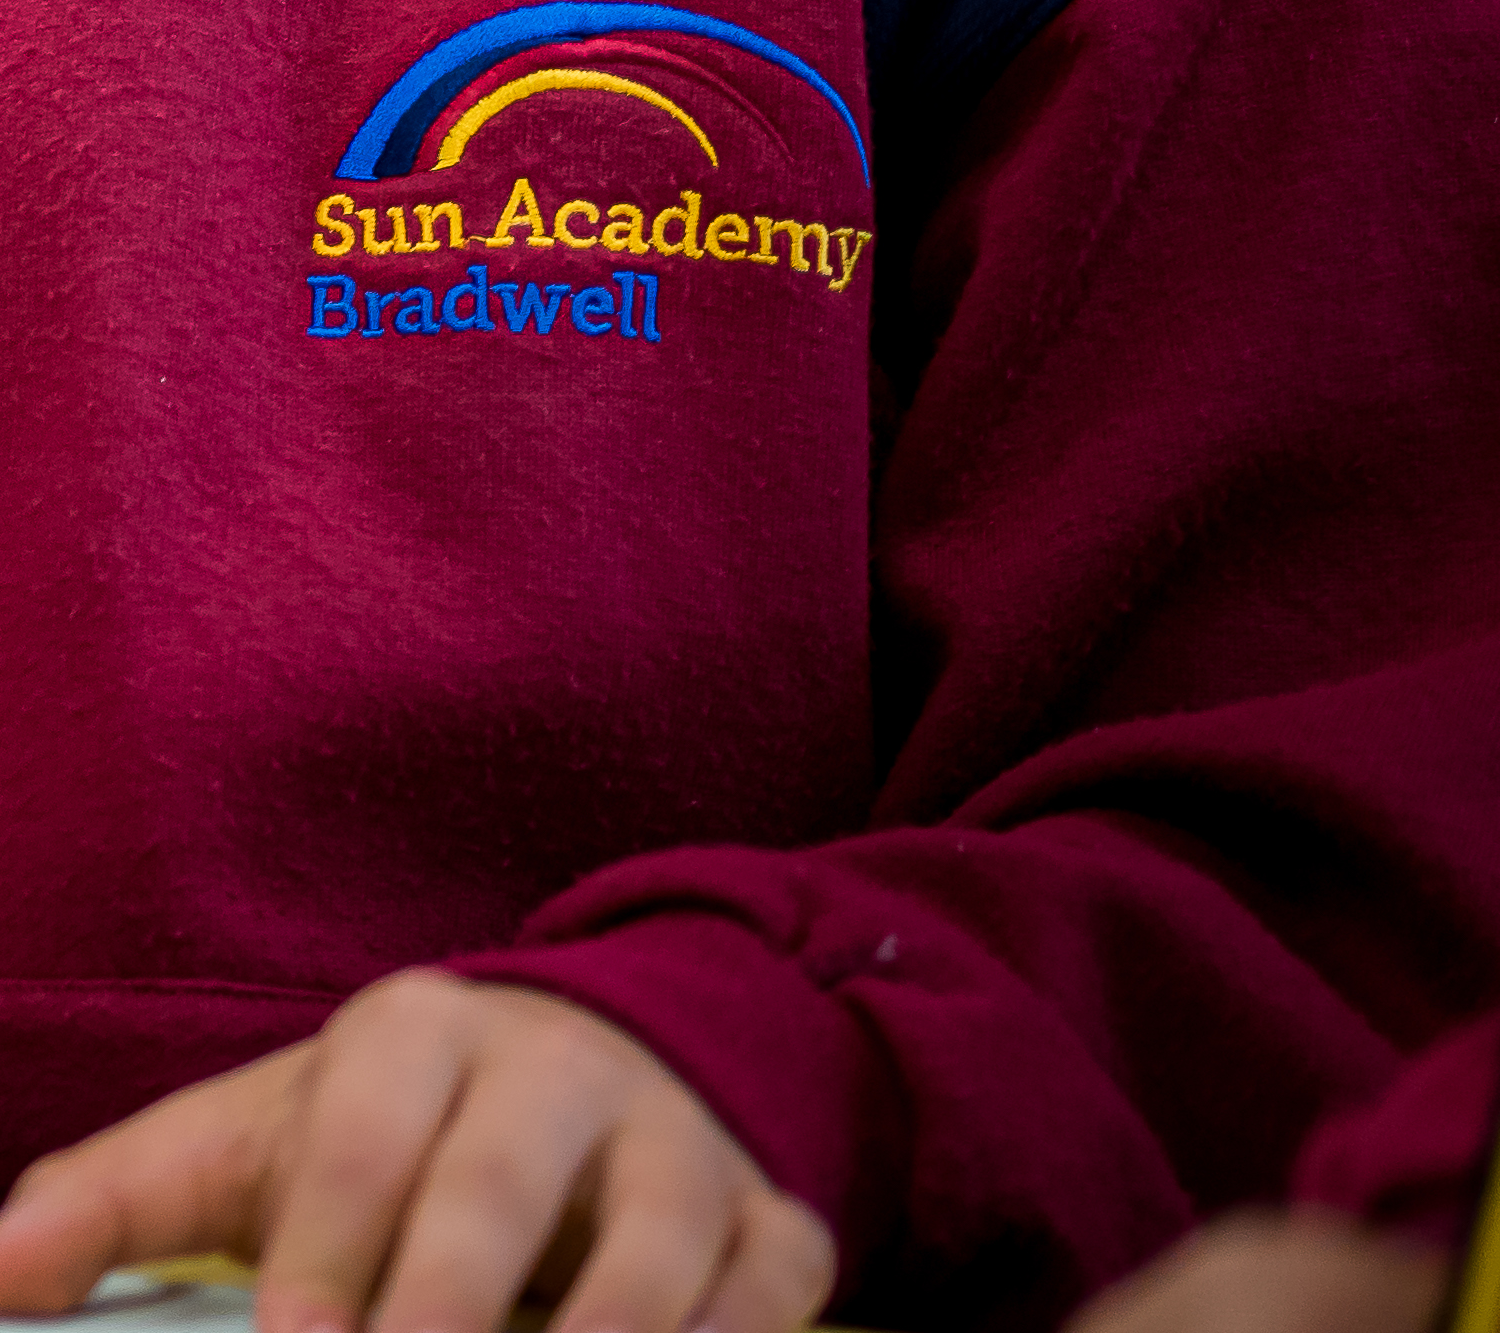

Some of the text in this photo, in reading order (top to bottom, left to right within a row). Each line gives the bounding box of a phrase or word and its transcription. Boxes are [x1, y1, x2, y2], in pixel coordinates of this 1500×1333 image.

[312, 178, 872, 292] Sun Academy
[306, 265, 662, 344] Bradwell
